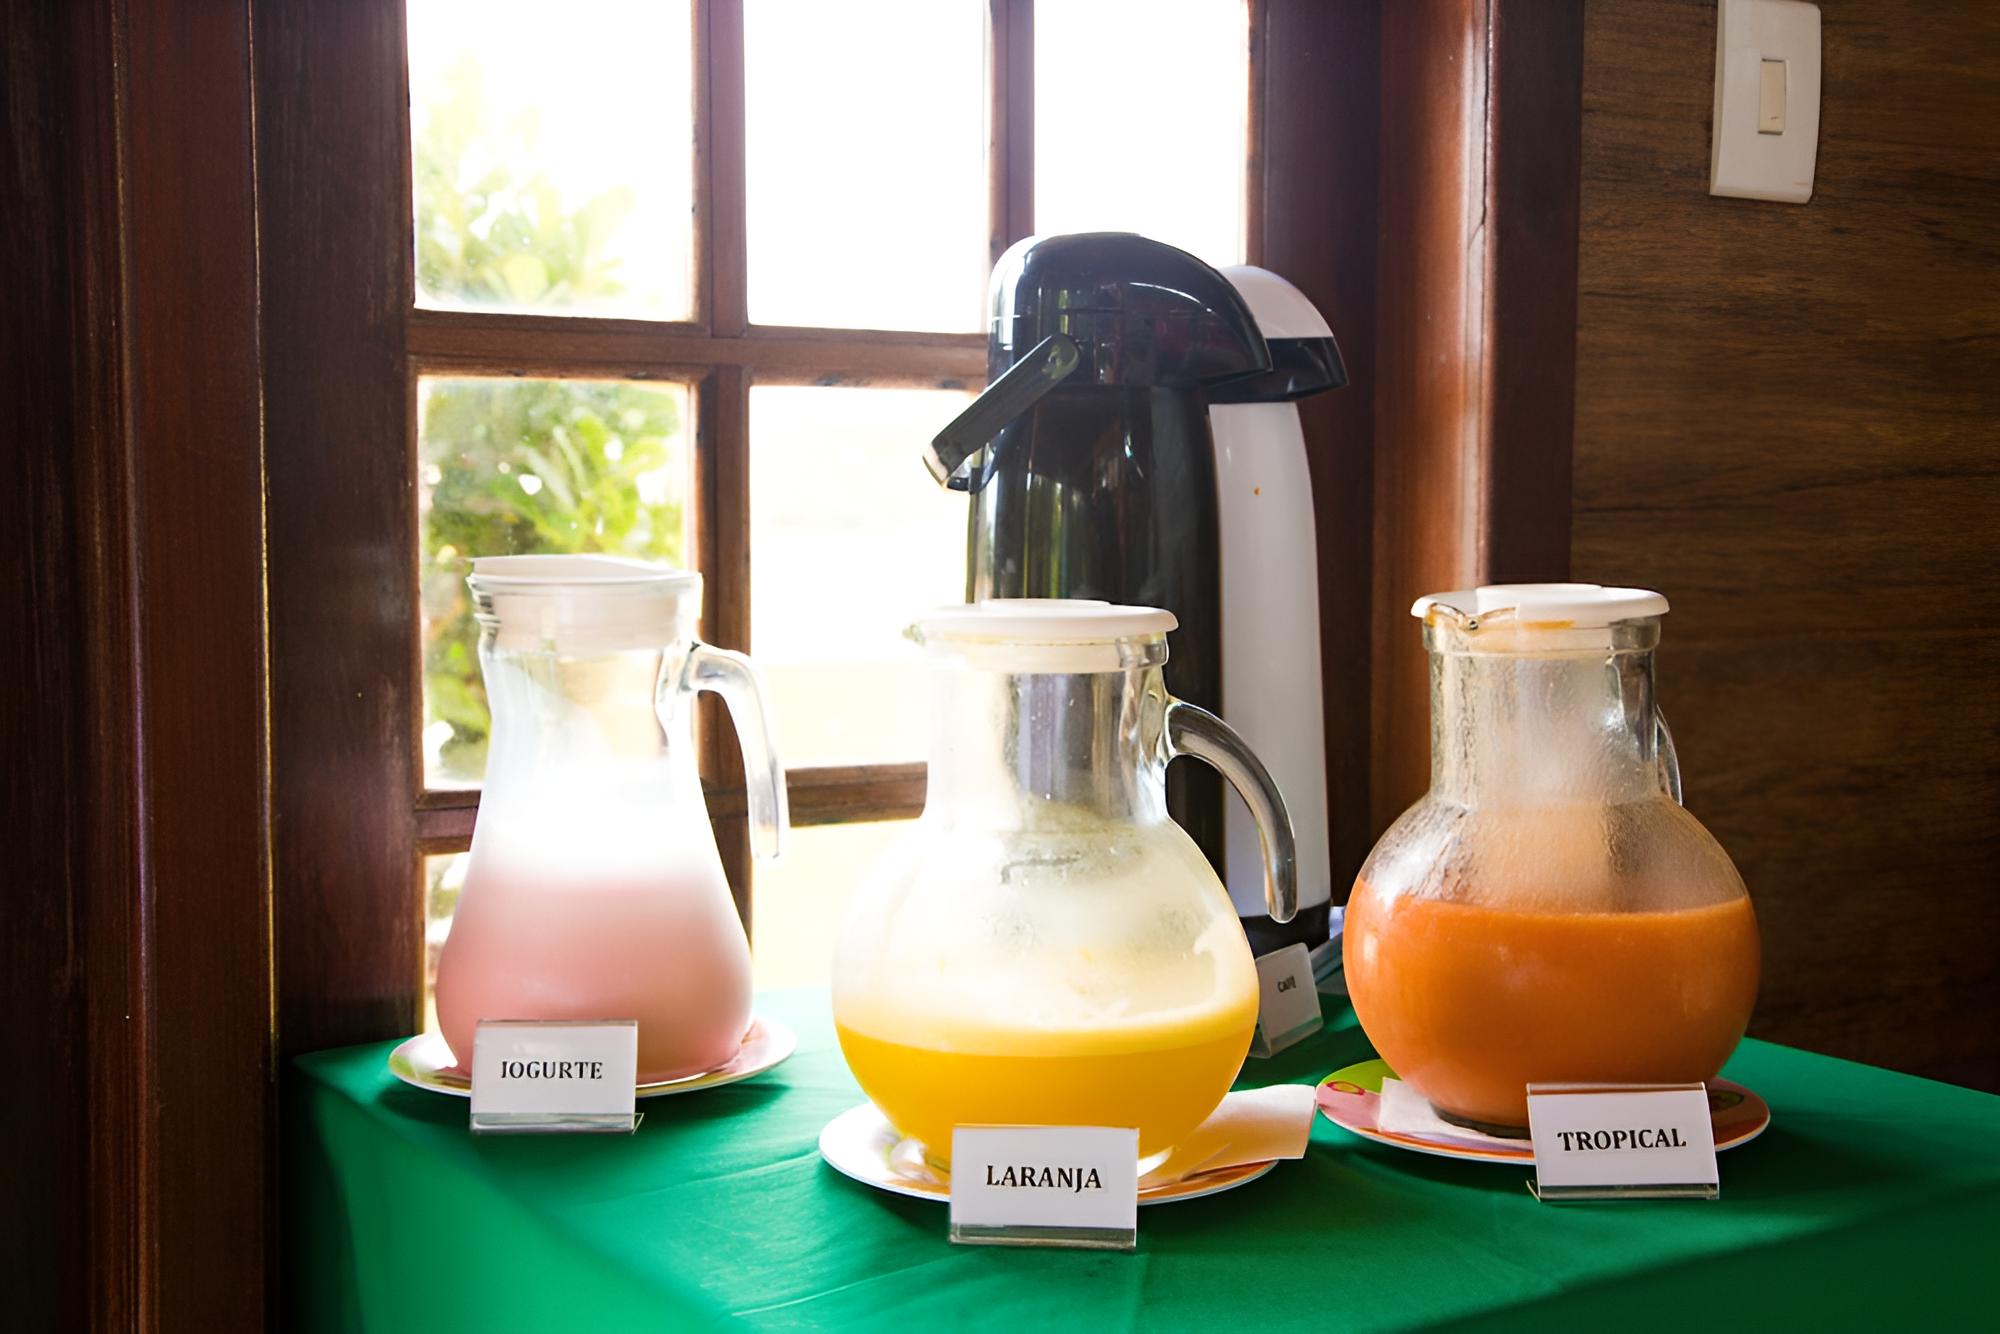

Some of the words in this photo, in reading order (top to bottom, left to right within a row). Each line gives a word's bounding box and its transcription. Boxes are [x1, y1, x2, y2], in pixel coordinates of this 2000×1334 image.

[501, 1061, 602, 1079] IOGURTE
[1556, 1127, 1686, 1151] TROPICAL
[986, 1165, 1101, 1192] LARANJA
